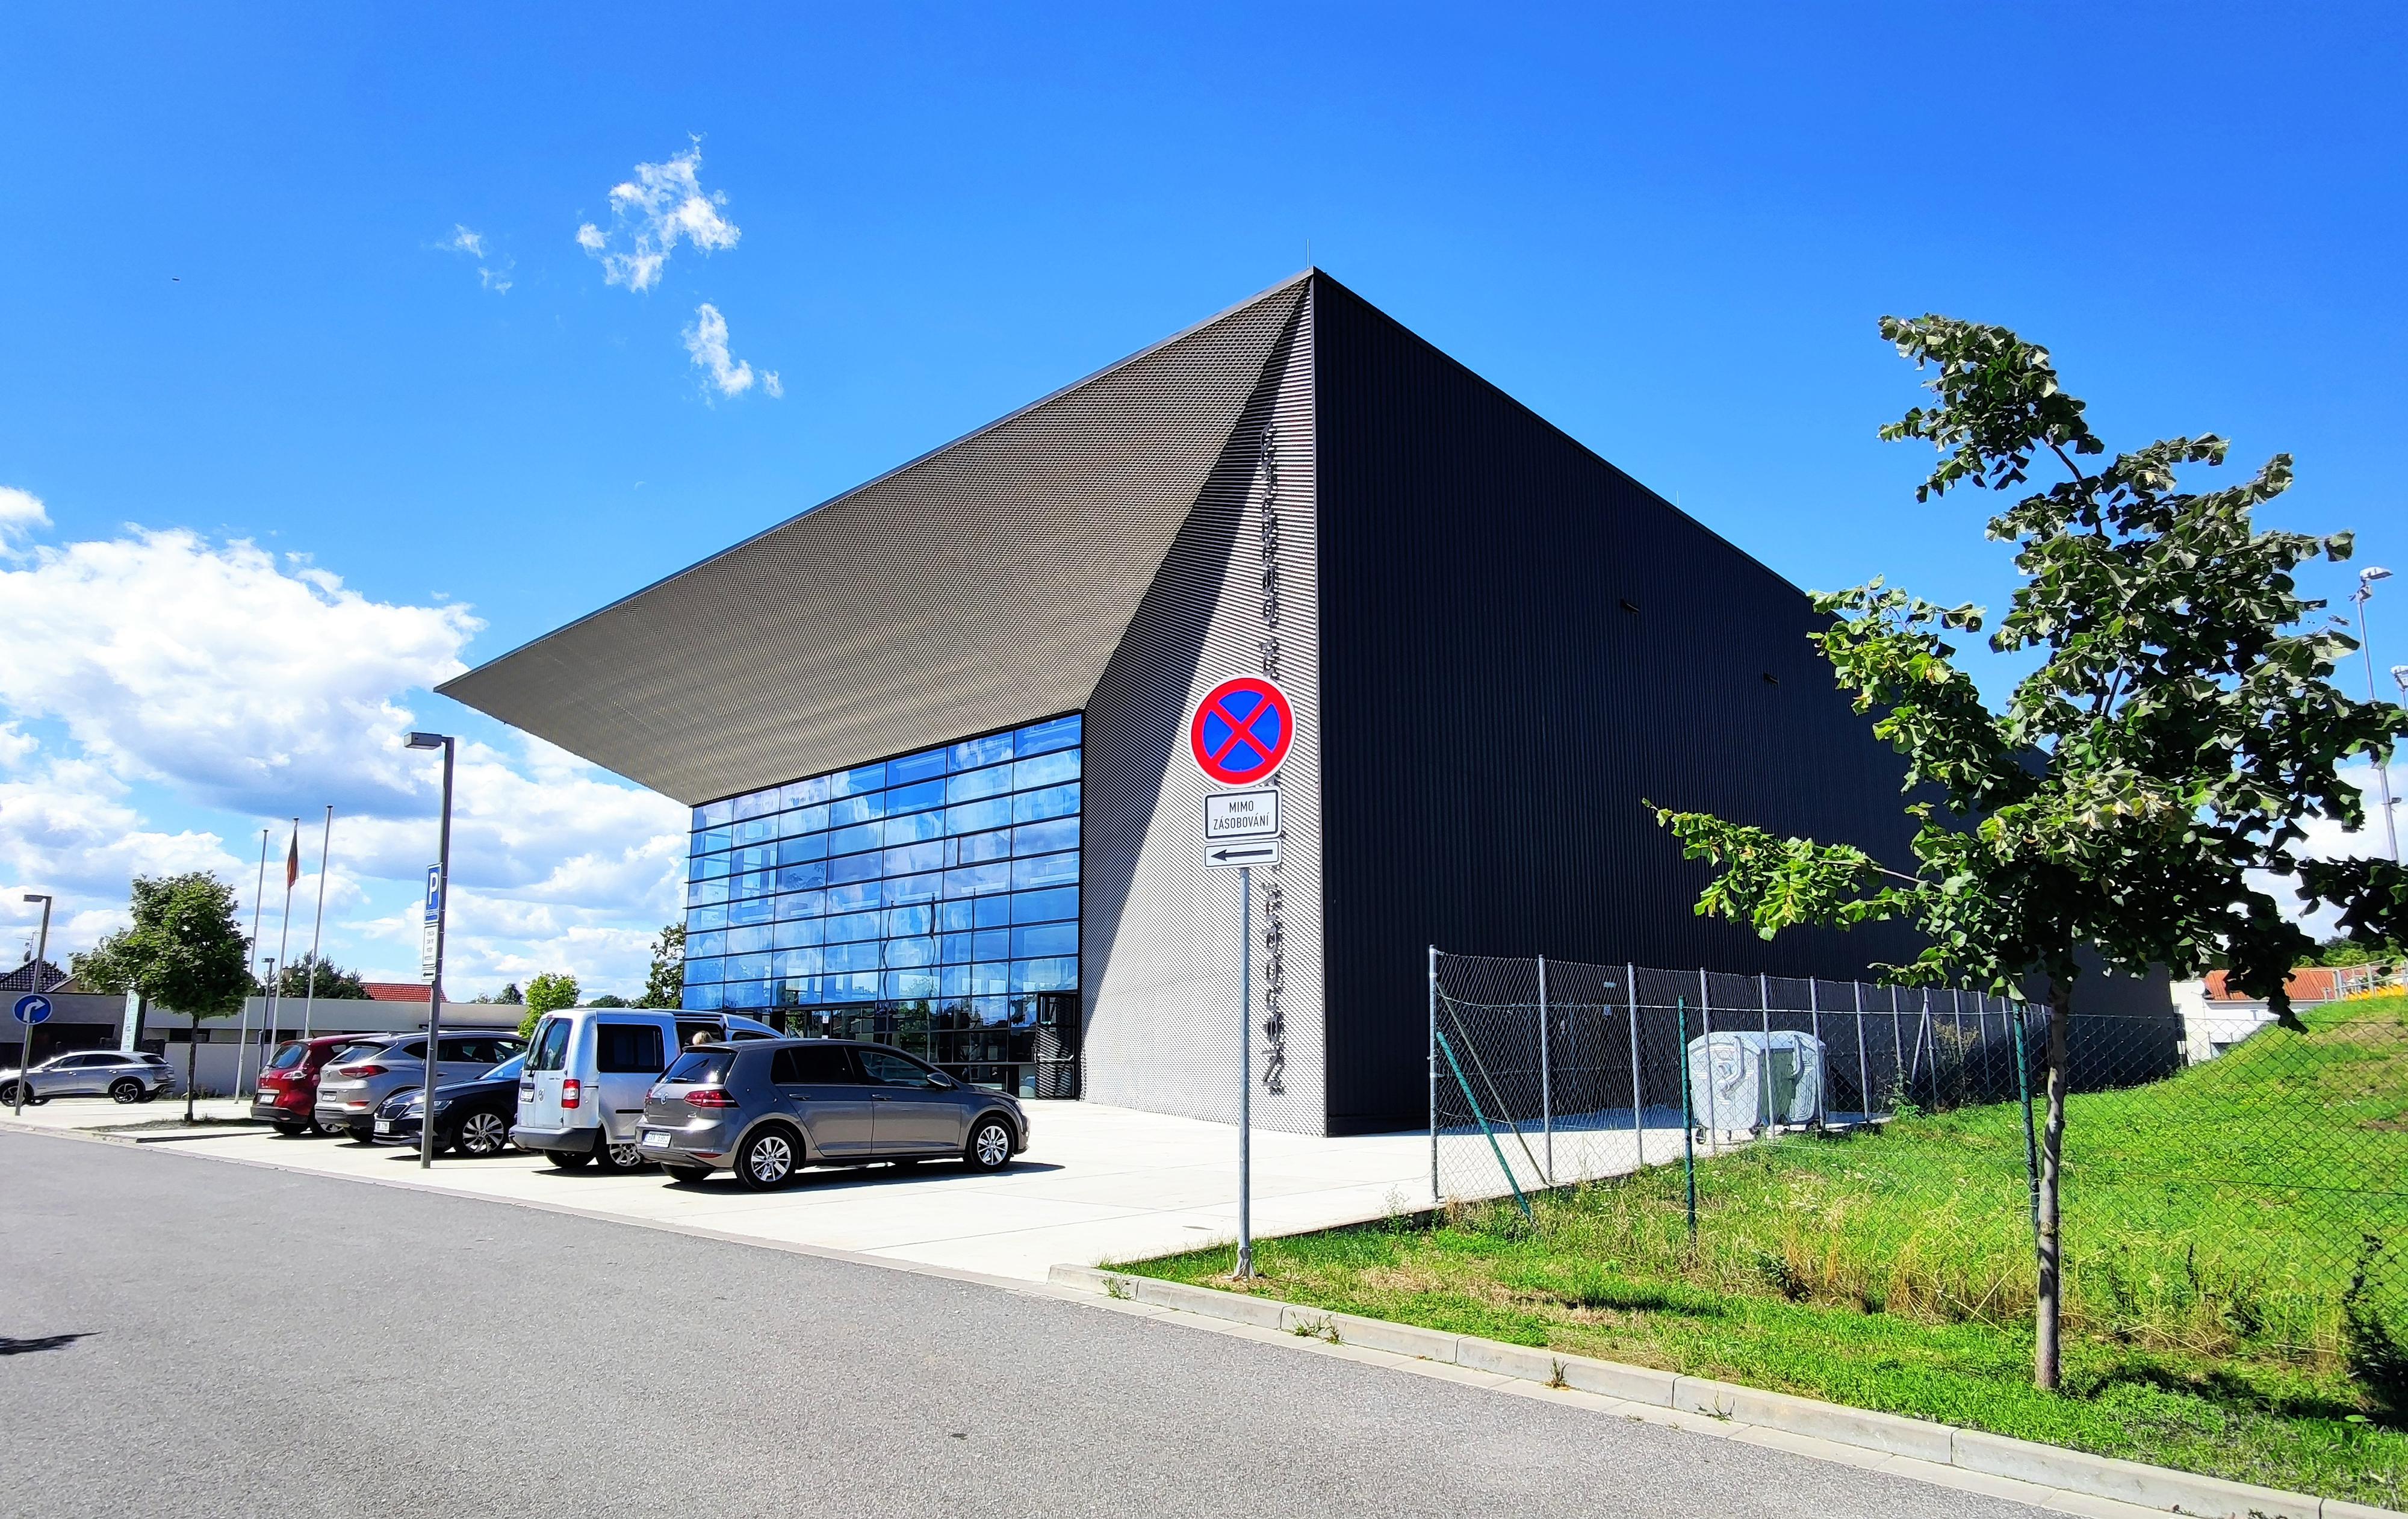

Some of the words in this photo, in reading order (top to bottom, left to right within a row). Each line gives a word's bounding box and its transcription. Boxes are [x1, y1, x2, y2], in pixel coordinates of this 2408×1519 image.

[1229, 801, 1254, 812] MIMO
[1214, 812, 1269, 830] ZÁSOBOVÁNÍ
[429, 872, 438, 905] P
